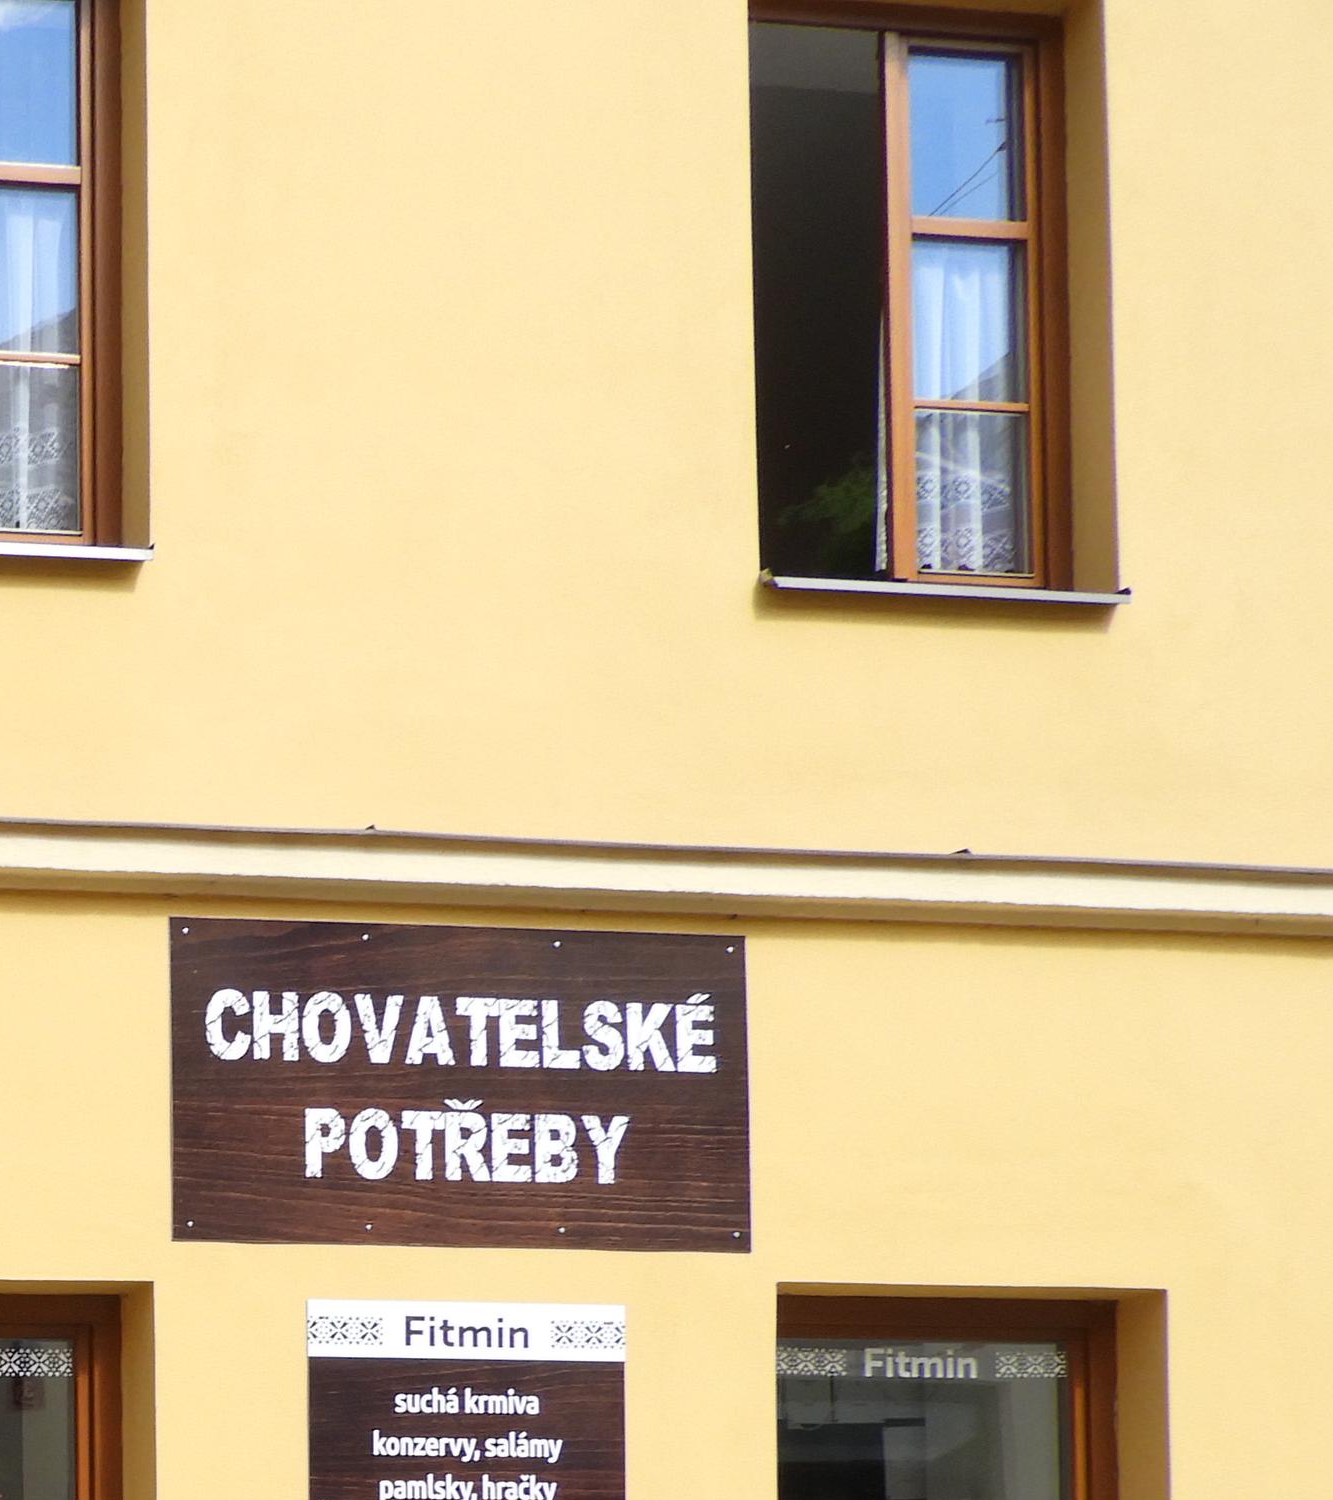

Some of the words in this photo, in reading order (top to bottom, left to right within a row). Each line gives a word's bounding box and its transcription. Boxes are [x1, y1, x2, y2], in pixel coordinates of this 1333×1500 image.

[204, 989, 718, 1073] CHOVATELSKÉ
[303, 1099, 630, 1184] POTŘEBY
[404, 1315, 530, 1349] Fitmin
[864, 1347, 978, 1379] Fitmin
[394, 1386, 459, 1415] suchá
[463, 1387, 540, 1415] krmiva
[372, 1429, 481, 1462] konzervy,
[485, 1431, 563, 1464] salámy
